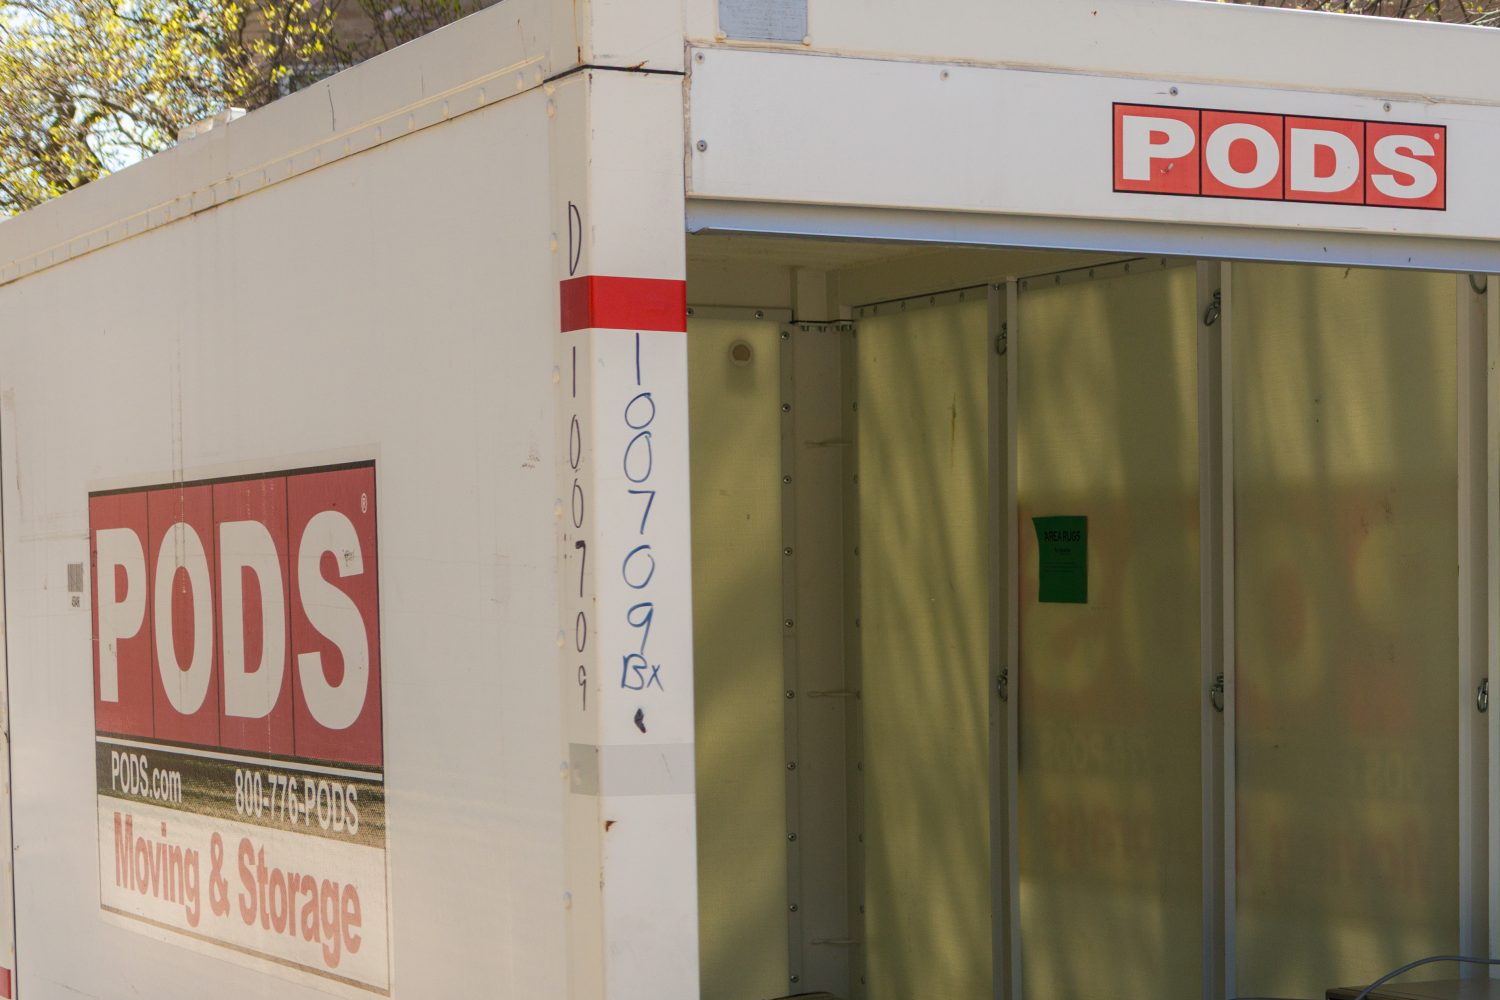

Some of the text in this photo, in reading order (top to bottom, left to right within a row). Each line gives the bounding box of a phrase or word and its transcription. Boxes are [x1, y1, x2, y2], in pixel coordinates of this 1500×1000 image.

[1122, 114, 1438, 199] PODS
[568, 201, 582, 276] D
[111, 750, 359, 835] PODS.com 800-776-PODS
[114, 811, 362, 968] Moving & Storage
